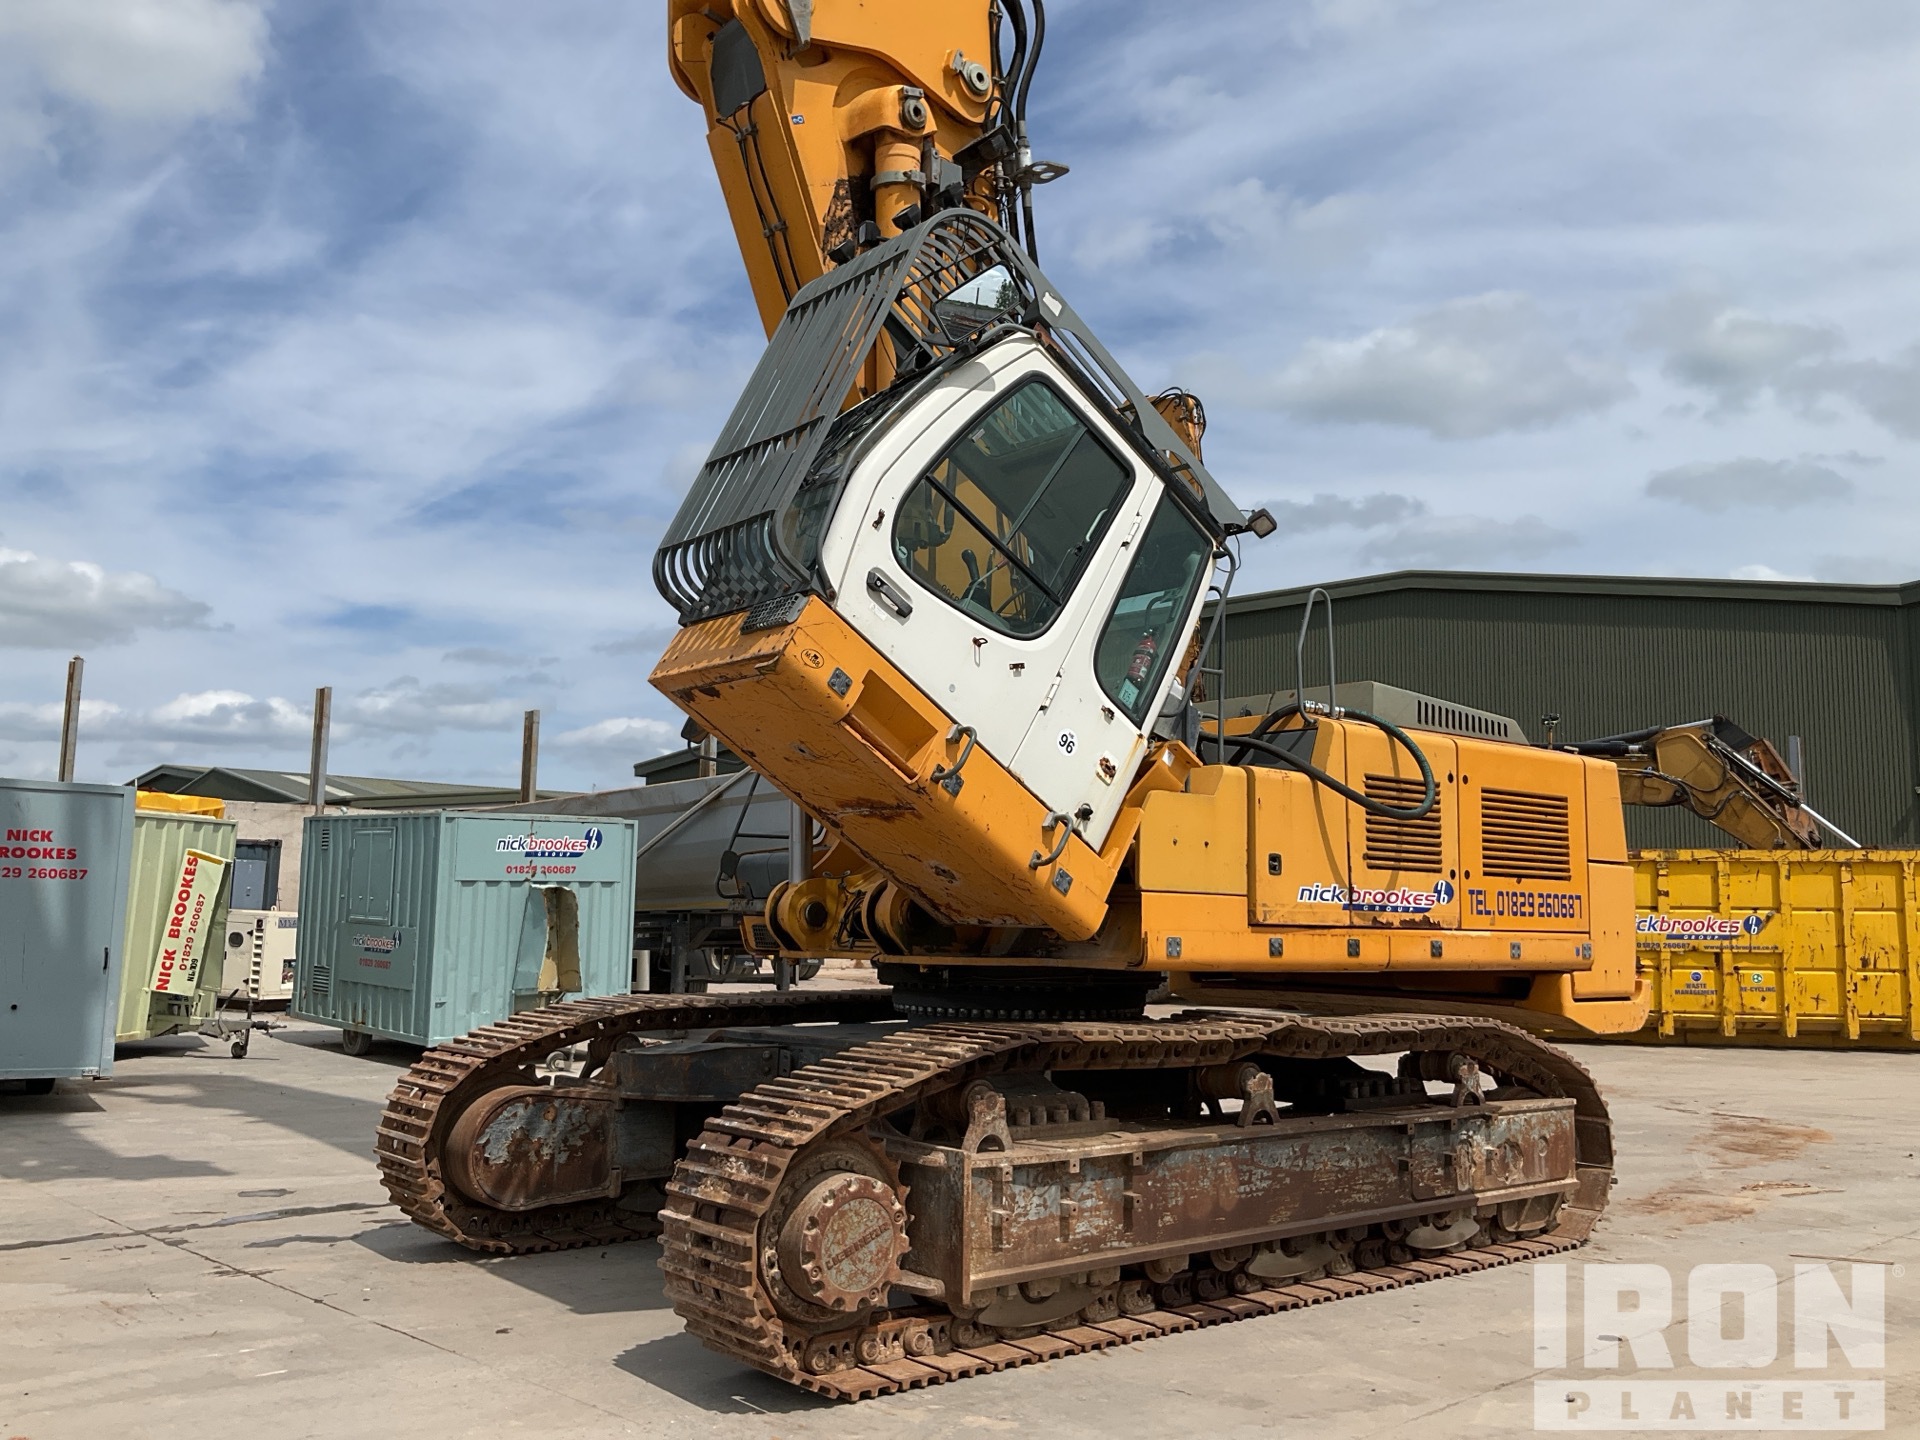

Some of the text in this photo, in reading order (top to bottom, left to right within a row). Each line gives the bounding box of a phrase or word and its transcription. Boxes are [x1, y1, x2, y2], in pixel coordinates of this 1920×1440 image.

[1058, 733, 1075, 754] 96
[6, 829, 53, 842] NICK
[0, 846, 77, 860] ROOKES
[0, 867, 88, 880] 29 260687
[506, 865, 577, 875] 01829 260687
[1363, 905, 1414, 913] GROUP
[1538, 893, 1583, 919] 260687
[155, 857, 199, 990] NICK BROOKES
[179, 893, 206, 970] 01829 260687
[1635, 915, 1740, 933] ckbrookes
